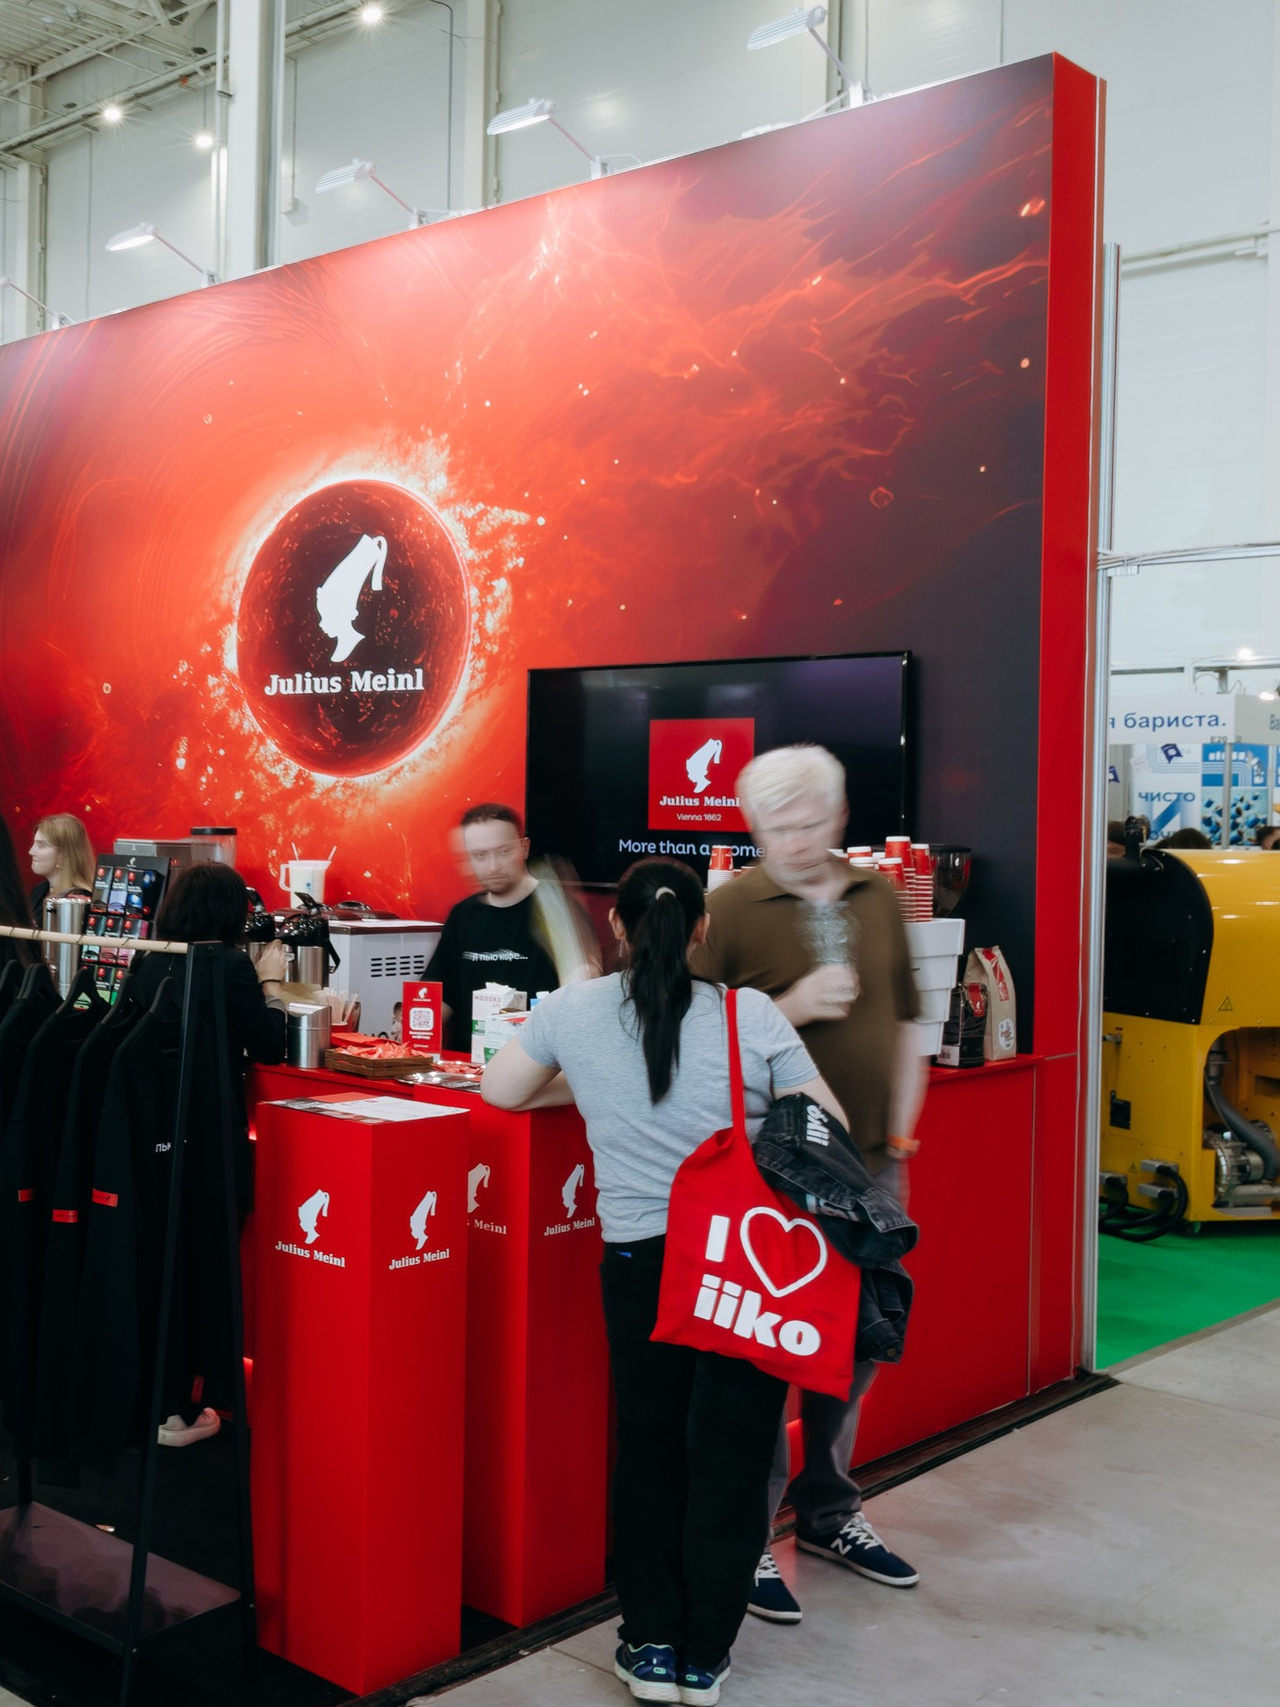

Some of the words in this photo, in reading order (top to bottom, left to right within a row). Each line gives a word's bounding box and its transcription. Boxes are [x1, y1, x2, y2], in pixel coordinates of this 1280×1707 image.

[264, 671, 343, 697] Julius
[350, 668, 425, 693] Meinl
[1124, 711, 1226, 732] бариста.
[659, 796, 700, 807] Julius
[676, 812, 703, 822] Vienna
[703, 812, 722, 822] 1862
[618, 838, 657, 854] More
[659, 839, 697, 855] than
[699, 844, 711, 856] a
[474, 1219, 508, 1235] Meinl
[543, 1223, 571, 1237] Julius
[572, 1217, 596, 1230] Meinl
[704, 1214, 731, 1263] I
[274, 1240, 311, 1259] Julius
[313, 1249, 346, 1268] Meinl
[388, 1255, 421, 1271] Julius
[422, 1248, 450, 1263] Meinl
[693, 1273, 822, 1357] iiko
